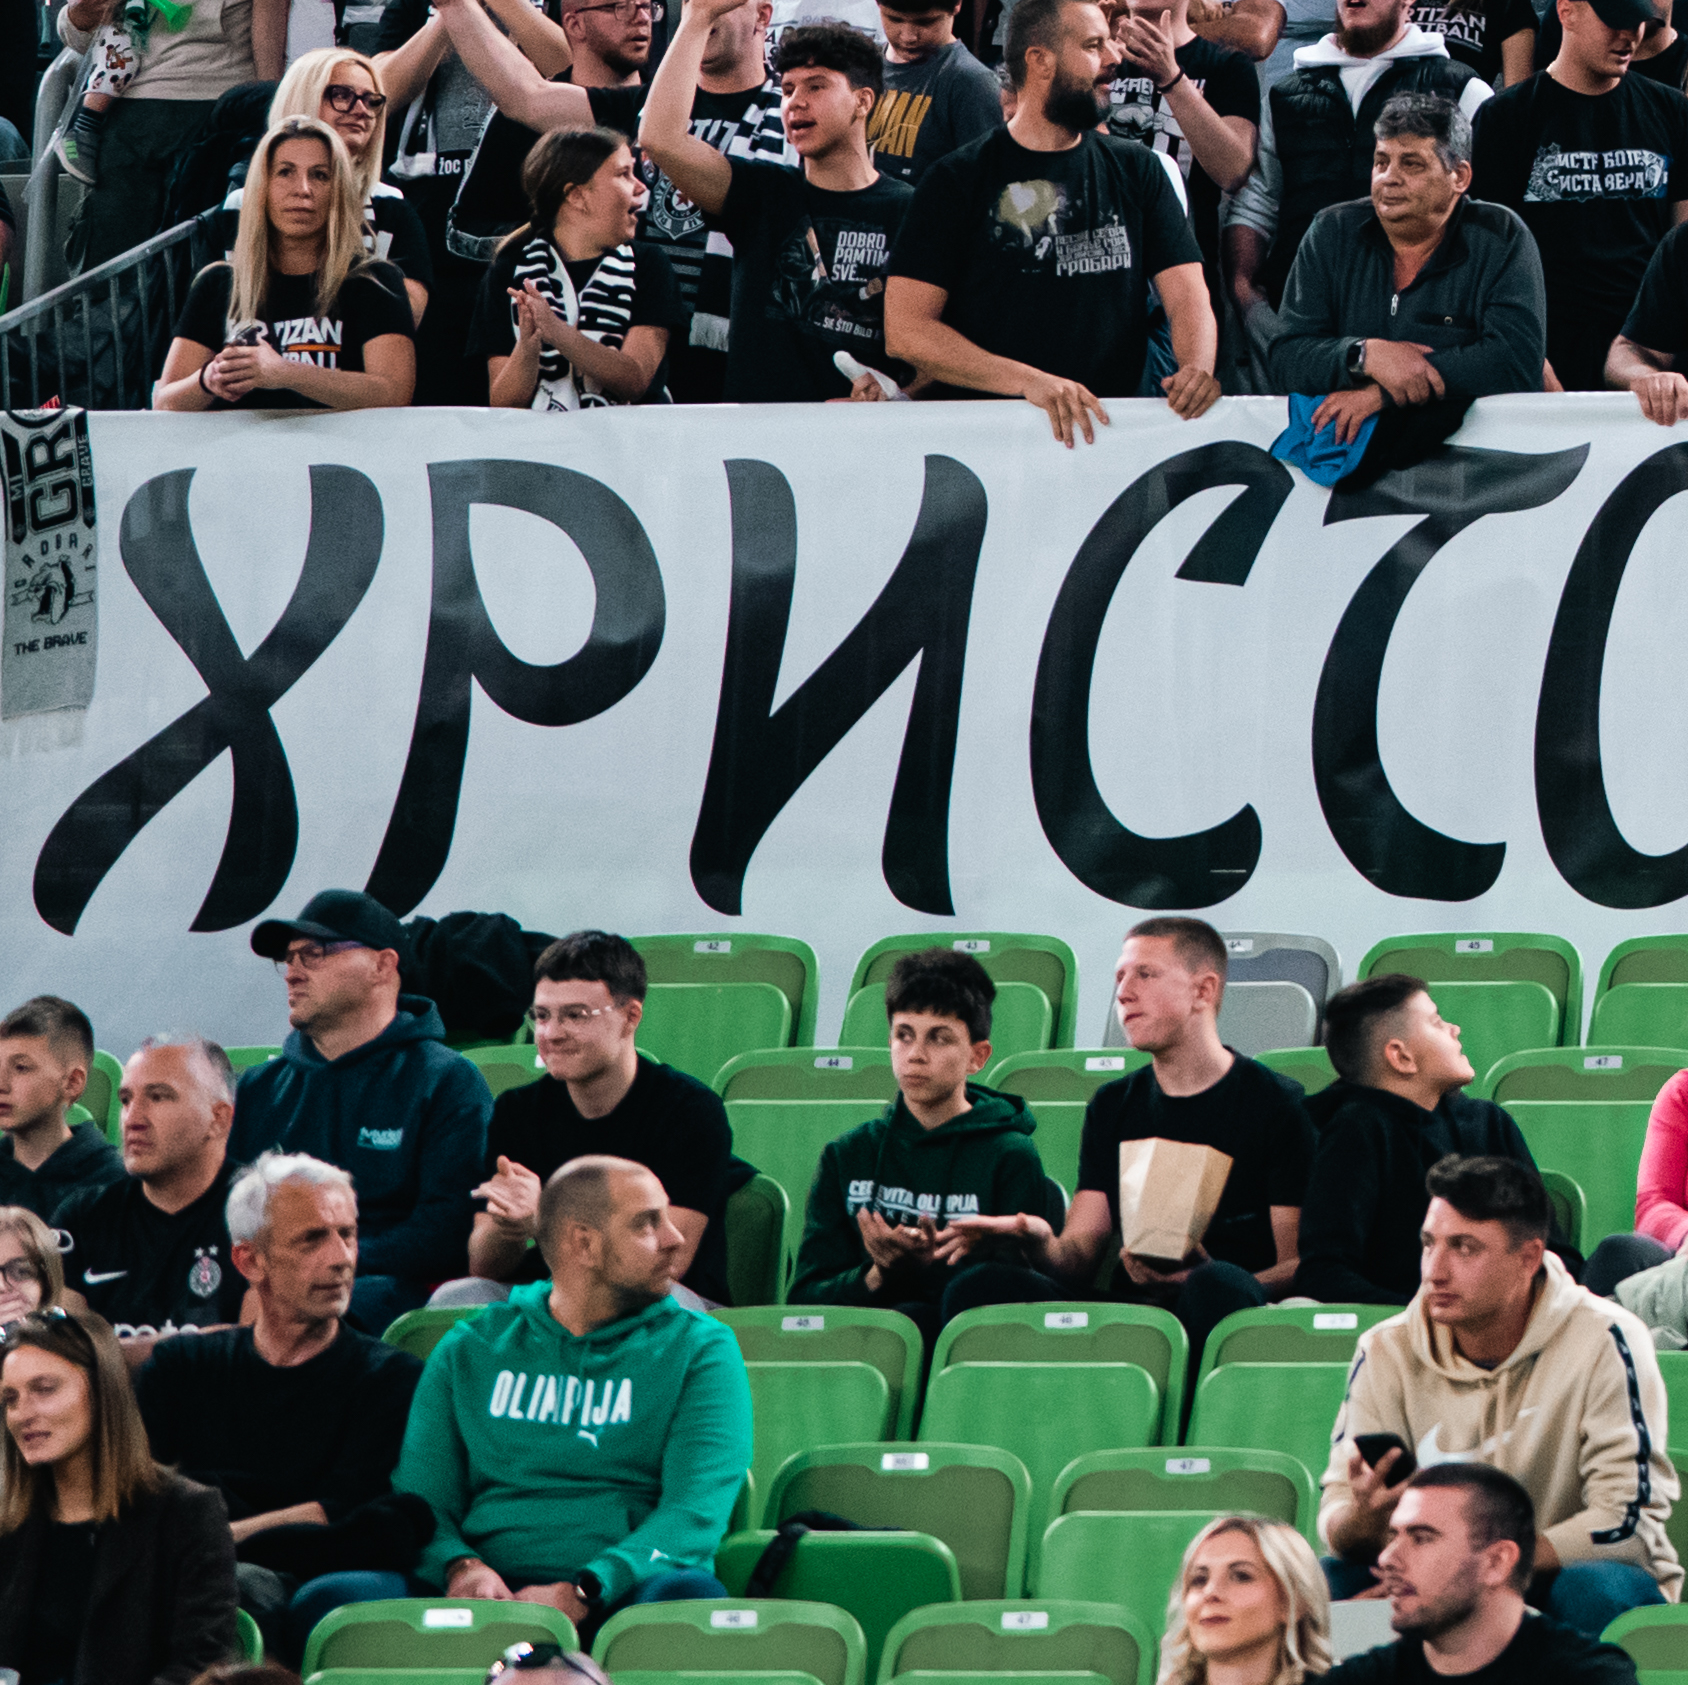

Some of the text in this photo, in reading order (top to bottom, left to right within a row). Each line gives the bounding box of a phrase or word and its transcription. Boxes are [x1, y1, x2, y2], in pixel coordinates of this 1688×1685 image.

[837, 230, 886, 250] DOBRO
[14, 631, 88, 655] THE BRAVE
